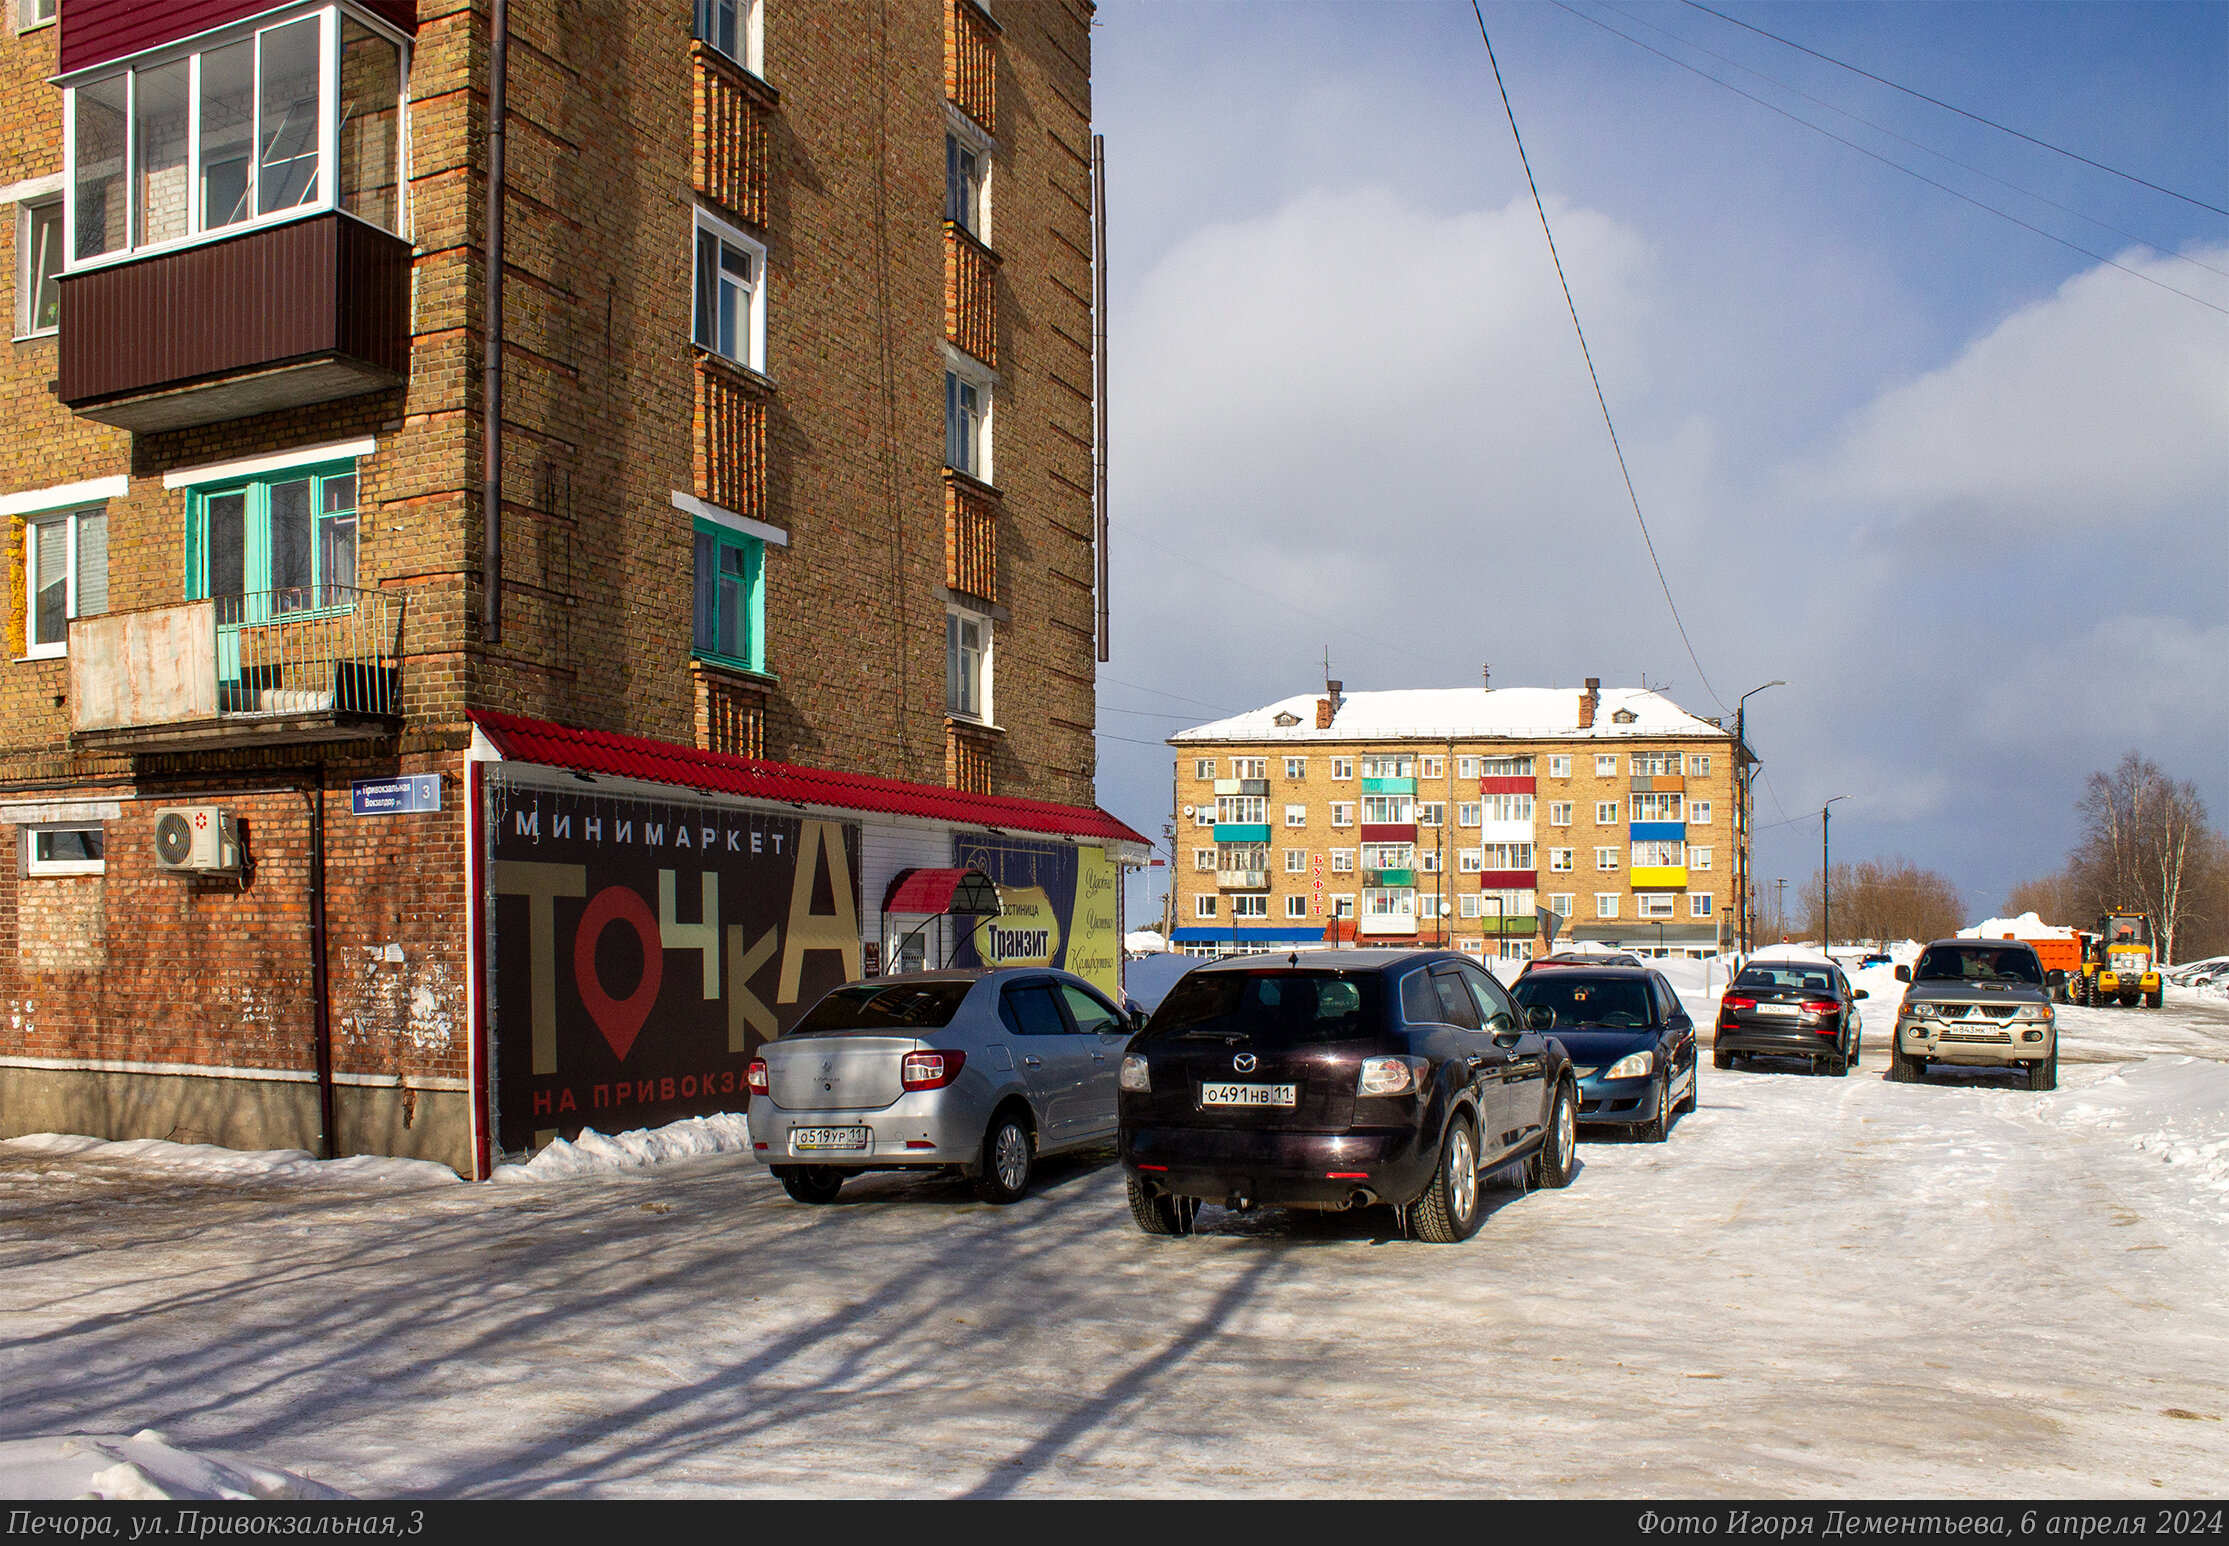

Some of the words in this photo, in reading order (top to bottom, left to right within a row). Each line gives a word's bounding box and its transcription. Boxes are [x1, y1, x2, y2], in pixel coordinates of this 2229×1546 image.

[363, 784, 411, 796] Привокзальная
[422, 784, 431, 799] 3
[515, 810, 784, 855] МИНИМАРКЕТ
[1312, 854, 1324, 915] БУФЕТ
[1003, 903, 1040, 918] ОСТИНИЦА
[494, 818, 861, 1076] ТОЧКА
[988, 924, 1048, 961] Транзит
[533, 1088, 577, 1116] НА
[1208, 1086, 1269, 1103] О491НВ
[1274, 1086, 1289, 1099] 11
[800, 1129, 846, 1143] О519УР
[849, 1128, 861, 1138] 11
